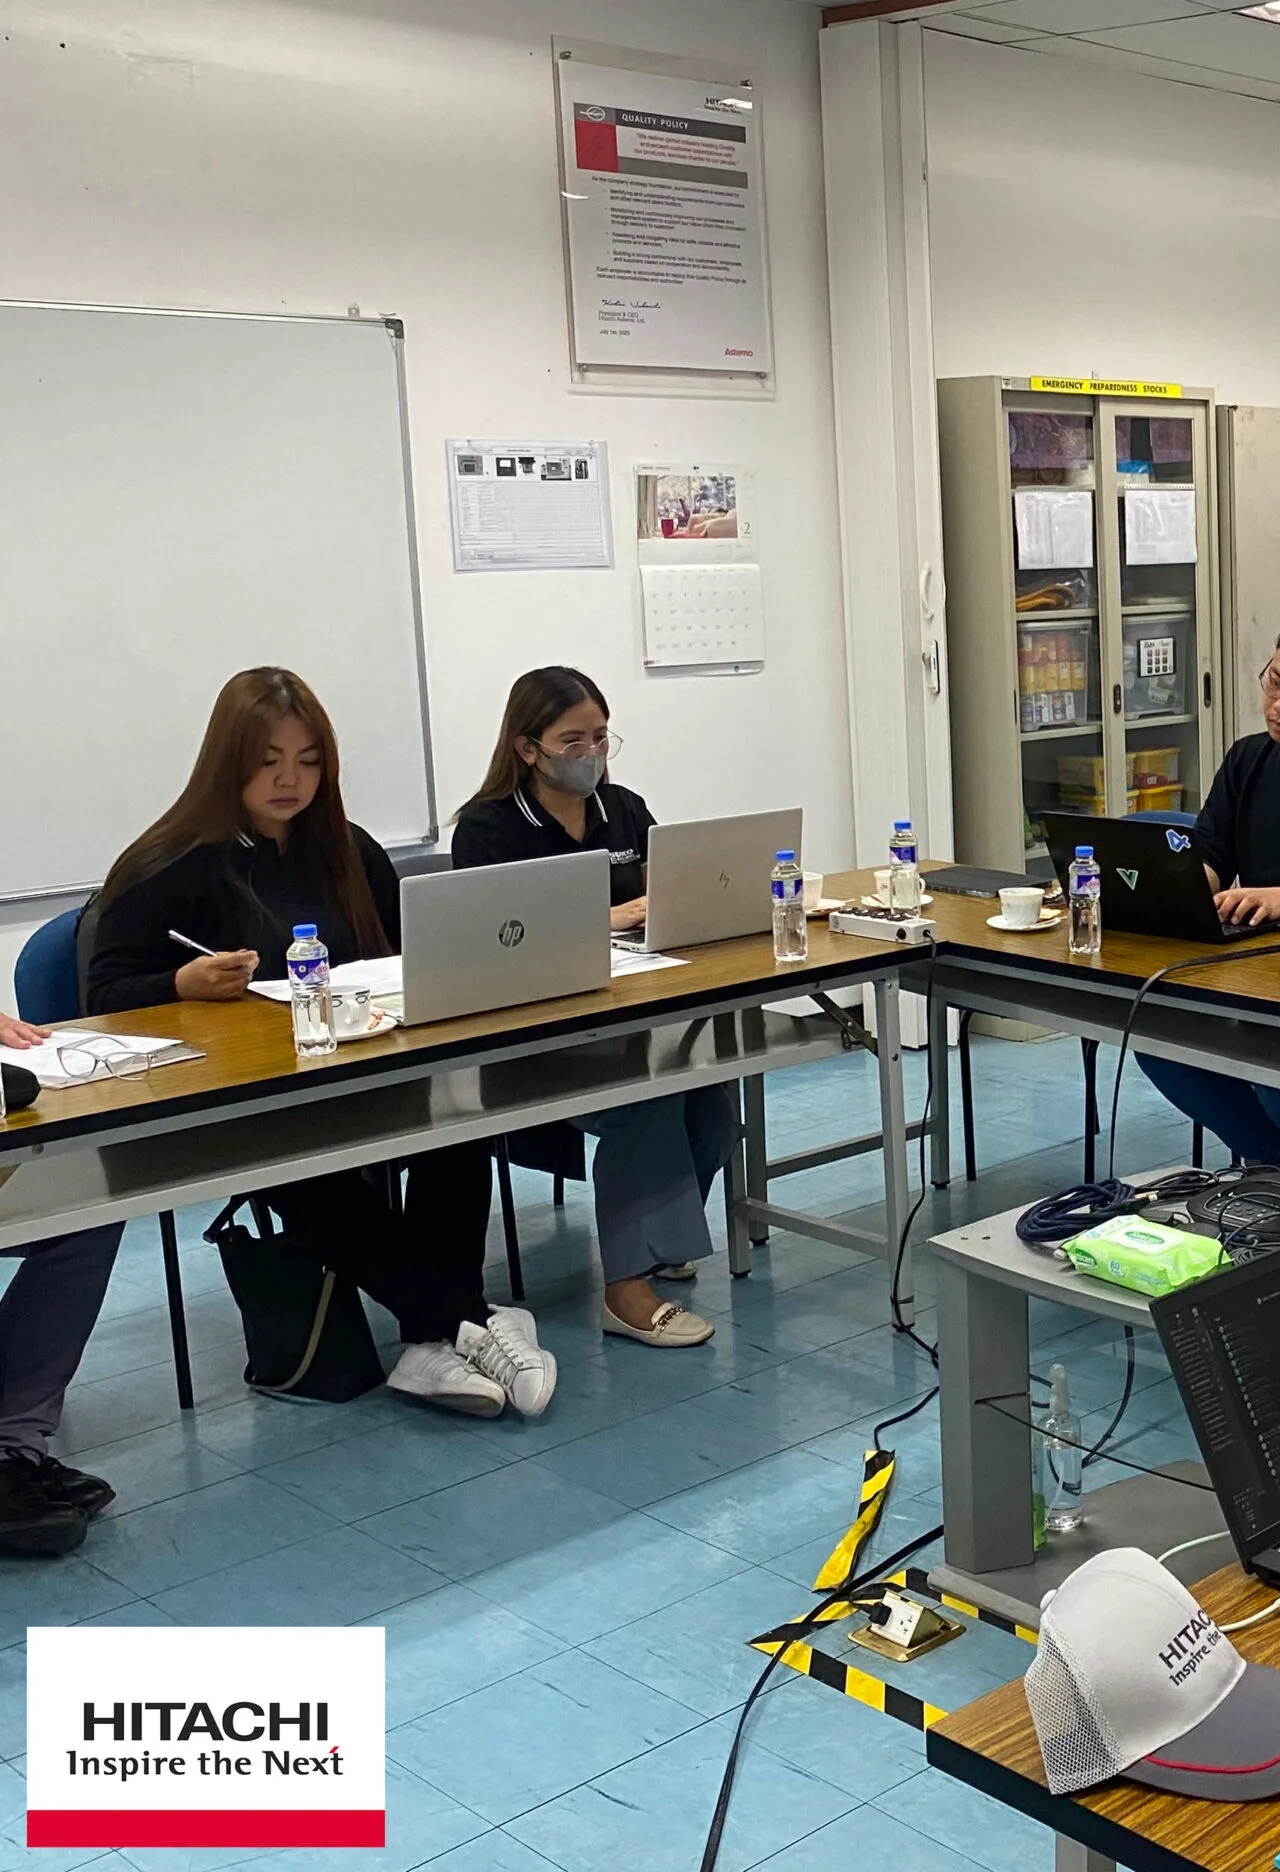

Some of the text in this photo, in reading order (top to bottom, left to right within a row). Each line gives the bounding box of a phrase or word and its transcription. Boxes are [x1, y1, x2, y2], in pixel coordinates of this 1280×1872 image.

[621, 113, 689, 130] QUALITY POLICY
[725, 348, 753, 357] Astemo
[1042, 379, 1167, 394] EMERGENCY PREPAREDNESS STOCKS
[743, 521, 752, 535] 2
[1158, 1609, 1211, 1669] HITAC
[1169, 1630, 1222, 1687] Inspire the
